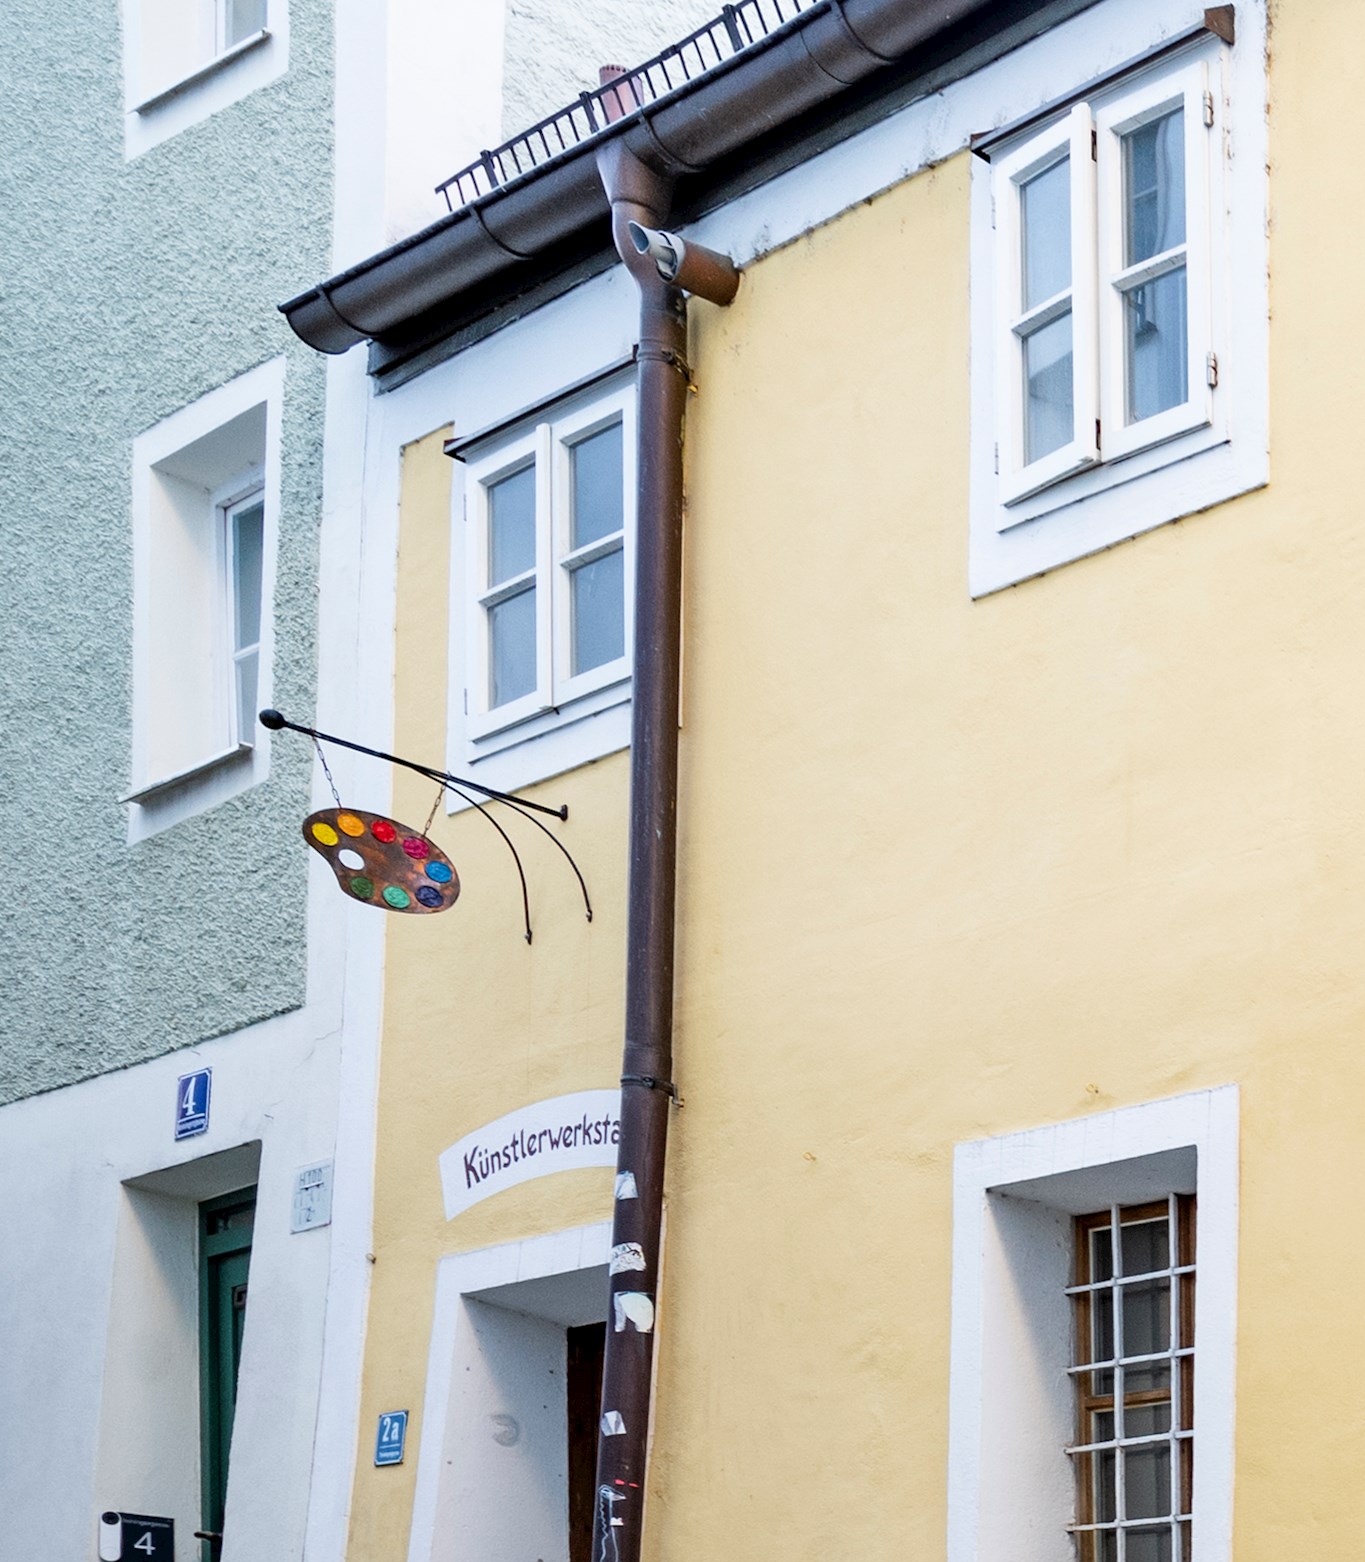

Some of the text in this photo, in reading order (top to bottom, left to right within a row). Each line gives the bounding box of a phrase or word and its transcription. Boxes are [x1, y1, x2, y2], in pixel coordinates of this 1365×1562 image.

[182, 1076, 197, 1116] 4
[382, 1416, 399, 1443] 2a
[133, 1531, 156, 1556] 4
